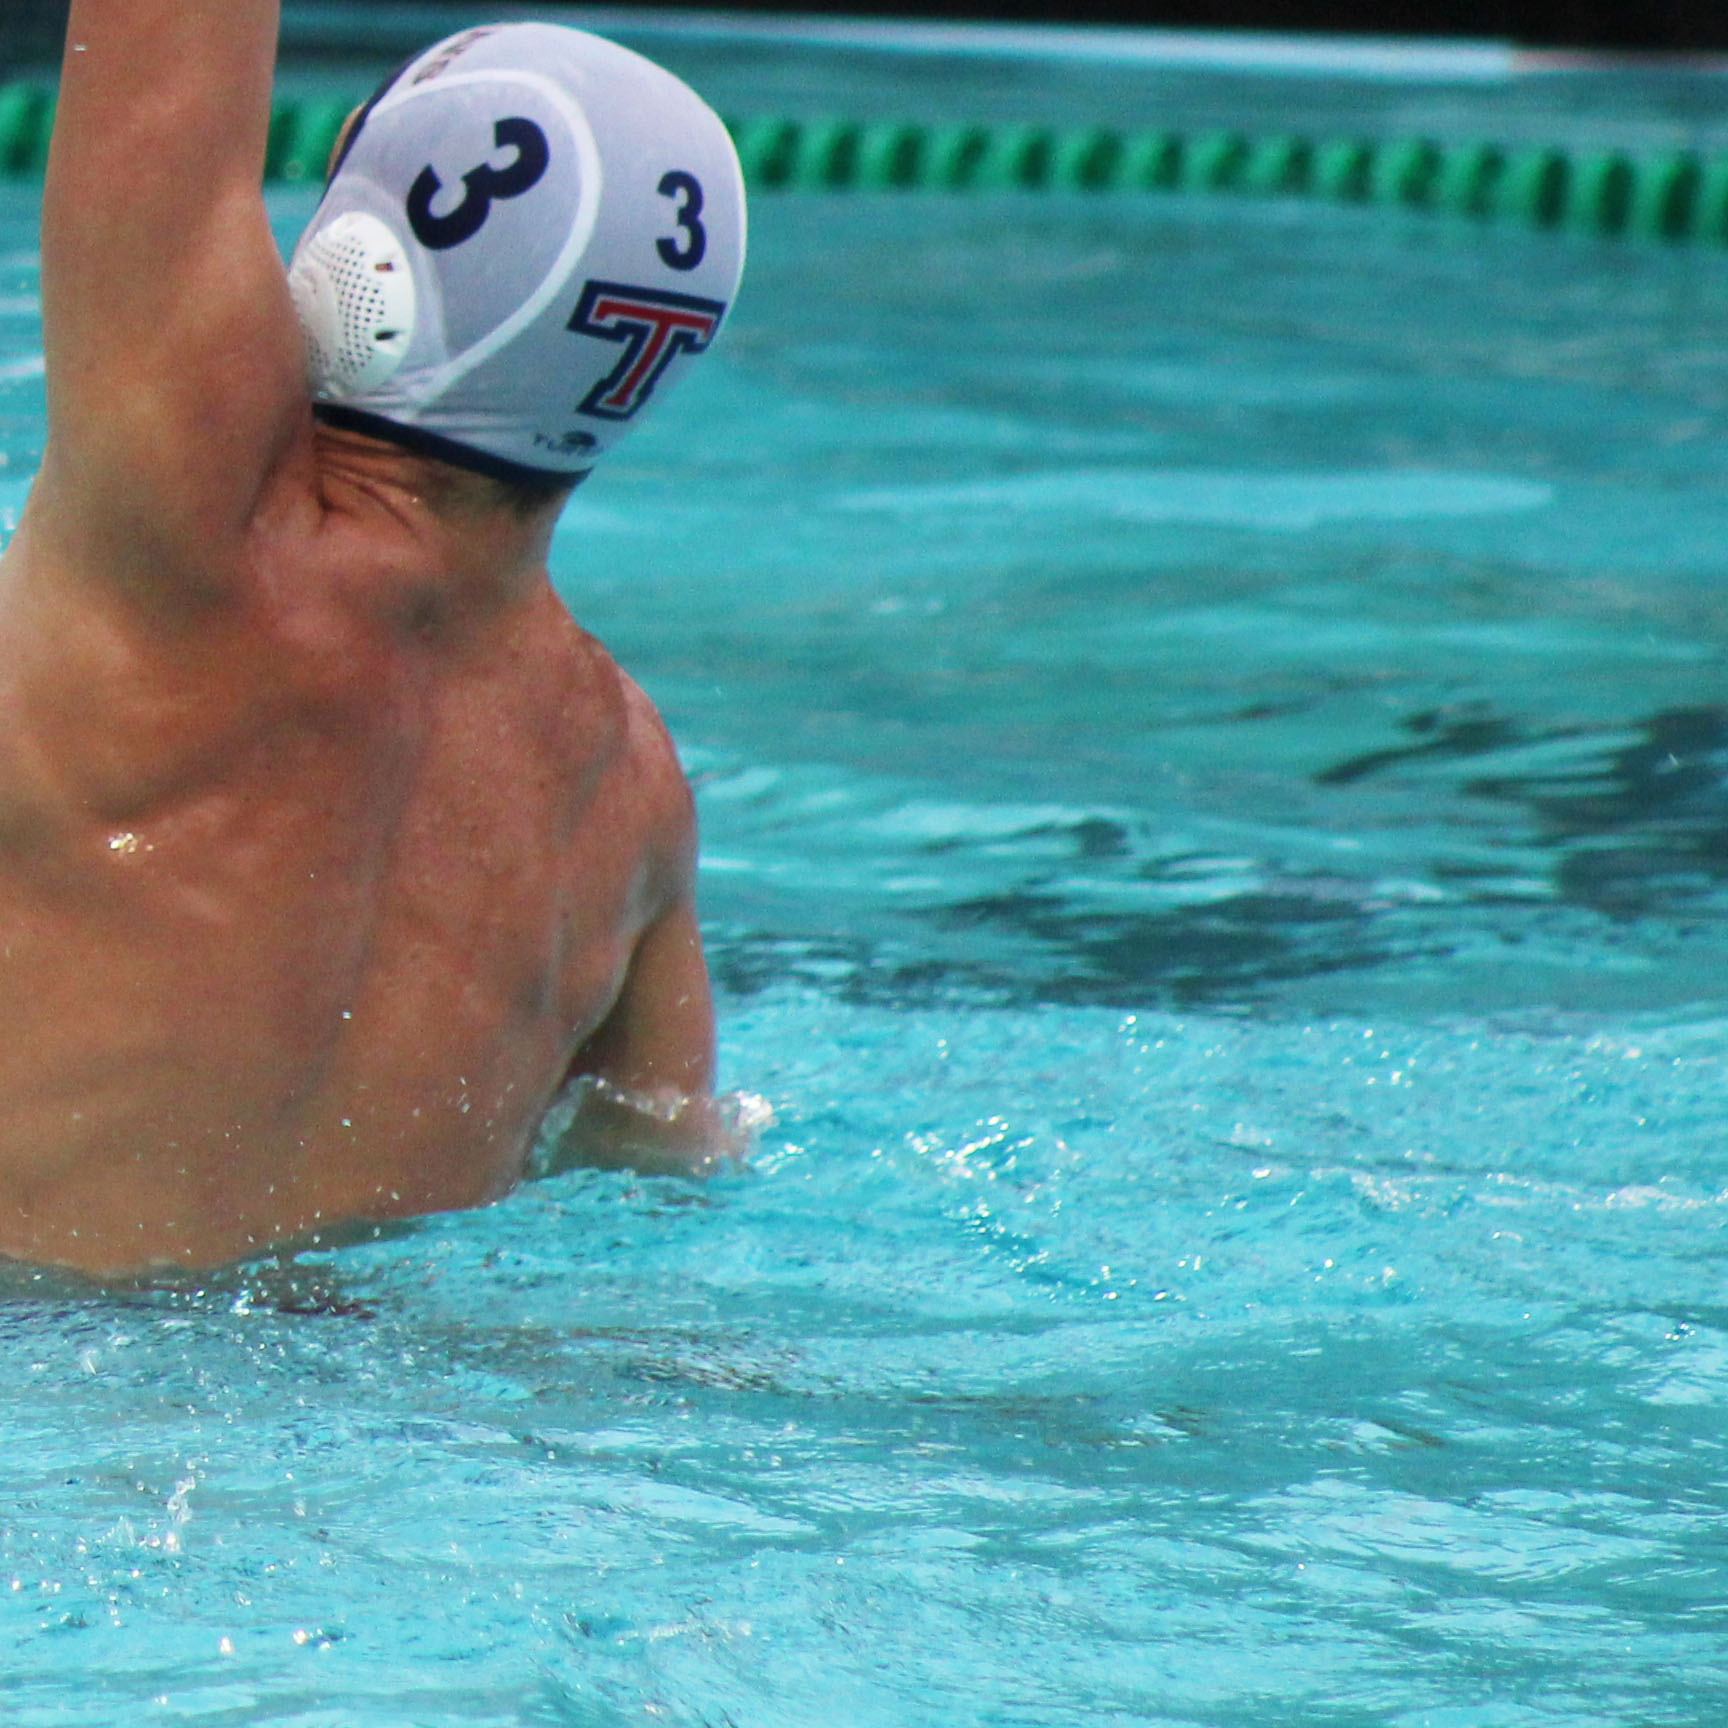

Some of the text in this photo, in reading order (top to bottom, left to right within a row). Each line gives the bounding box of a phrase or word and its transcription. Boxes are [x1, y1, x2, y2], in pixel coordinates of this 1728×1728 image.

[406, 116, 550, 250] 3
[656, 171, 707, 271] 3
[566, 279, 727, 421] T
